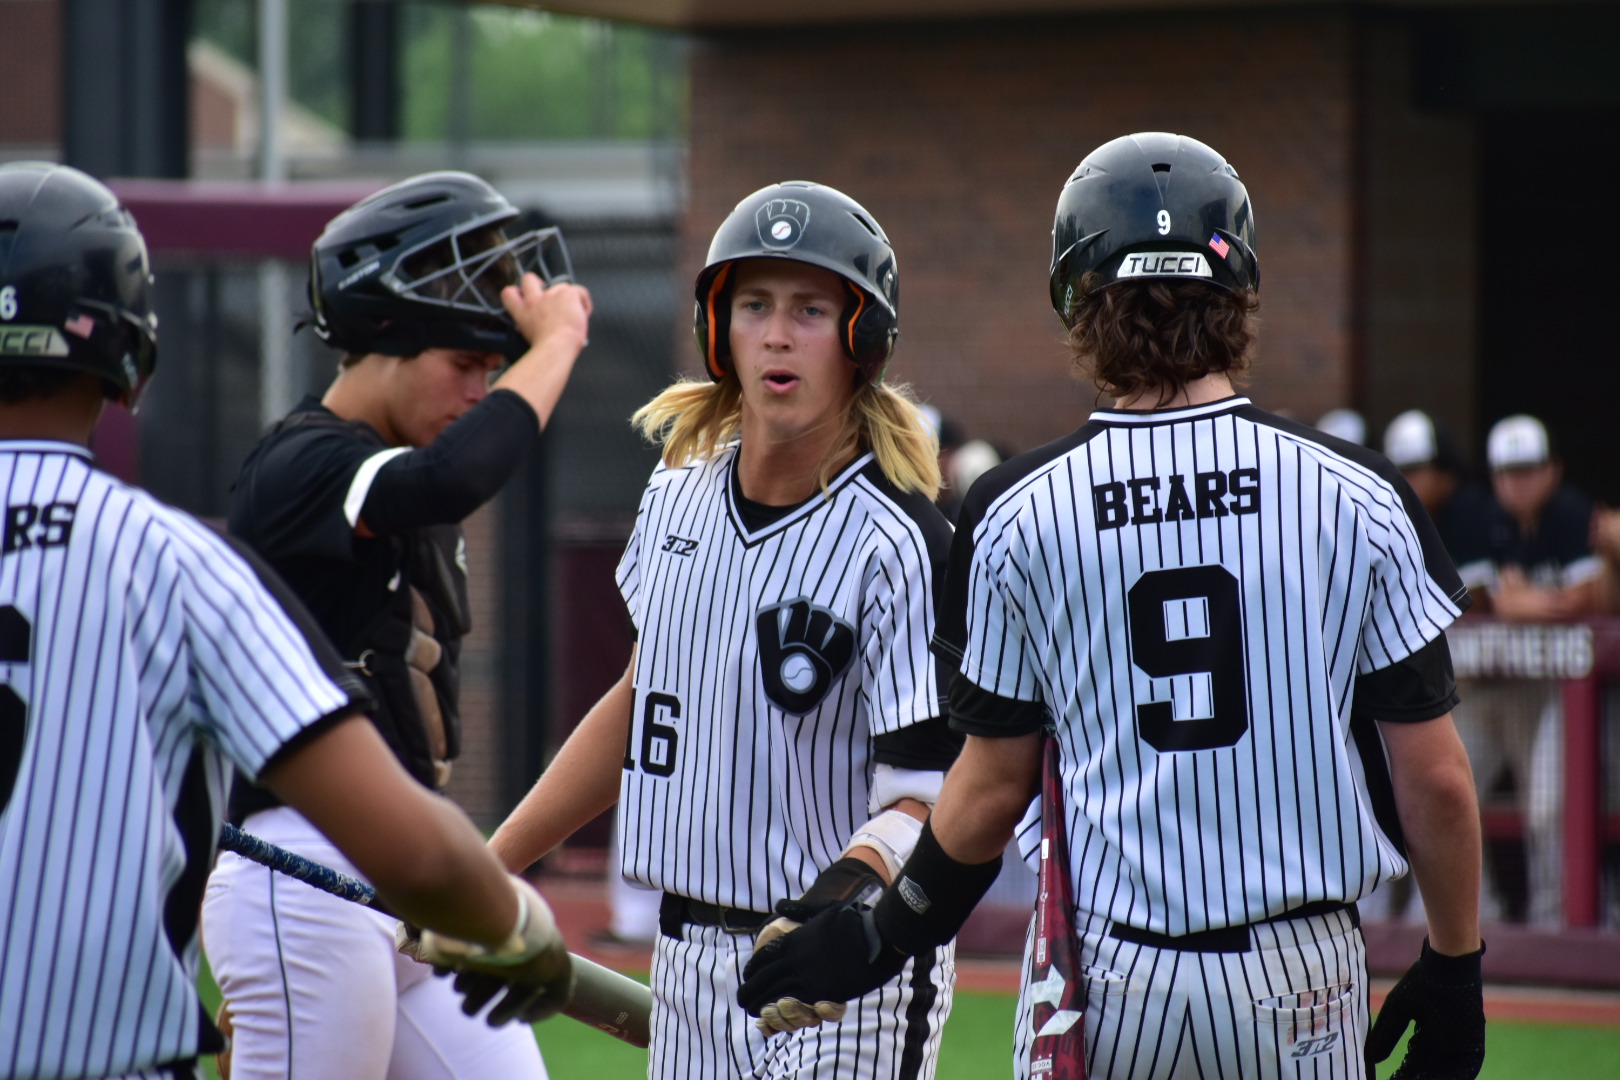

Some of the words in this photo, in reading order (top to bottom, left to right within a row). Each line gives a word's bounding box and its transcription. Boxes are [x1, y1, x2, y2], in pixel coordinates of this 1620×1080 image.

[1156, 209, 1171, 236] 9
[1129, 256, 1201, 274] TUCCI
[0, 285, 18, 321] 6
[0, 329, 52, 353] CCI
[1093, 467, 1259, 531] BEARS
[0, 501, 78, 556] RS
[1128, 563, 1249, 753] 9
[1447, 624, 1594, 679] NTHERS
[623, 688, 681, 778] 16
